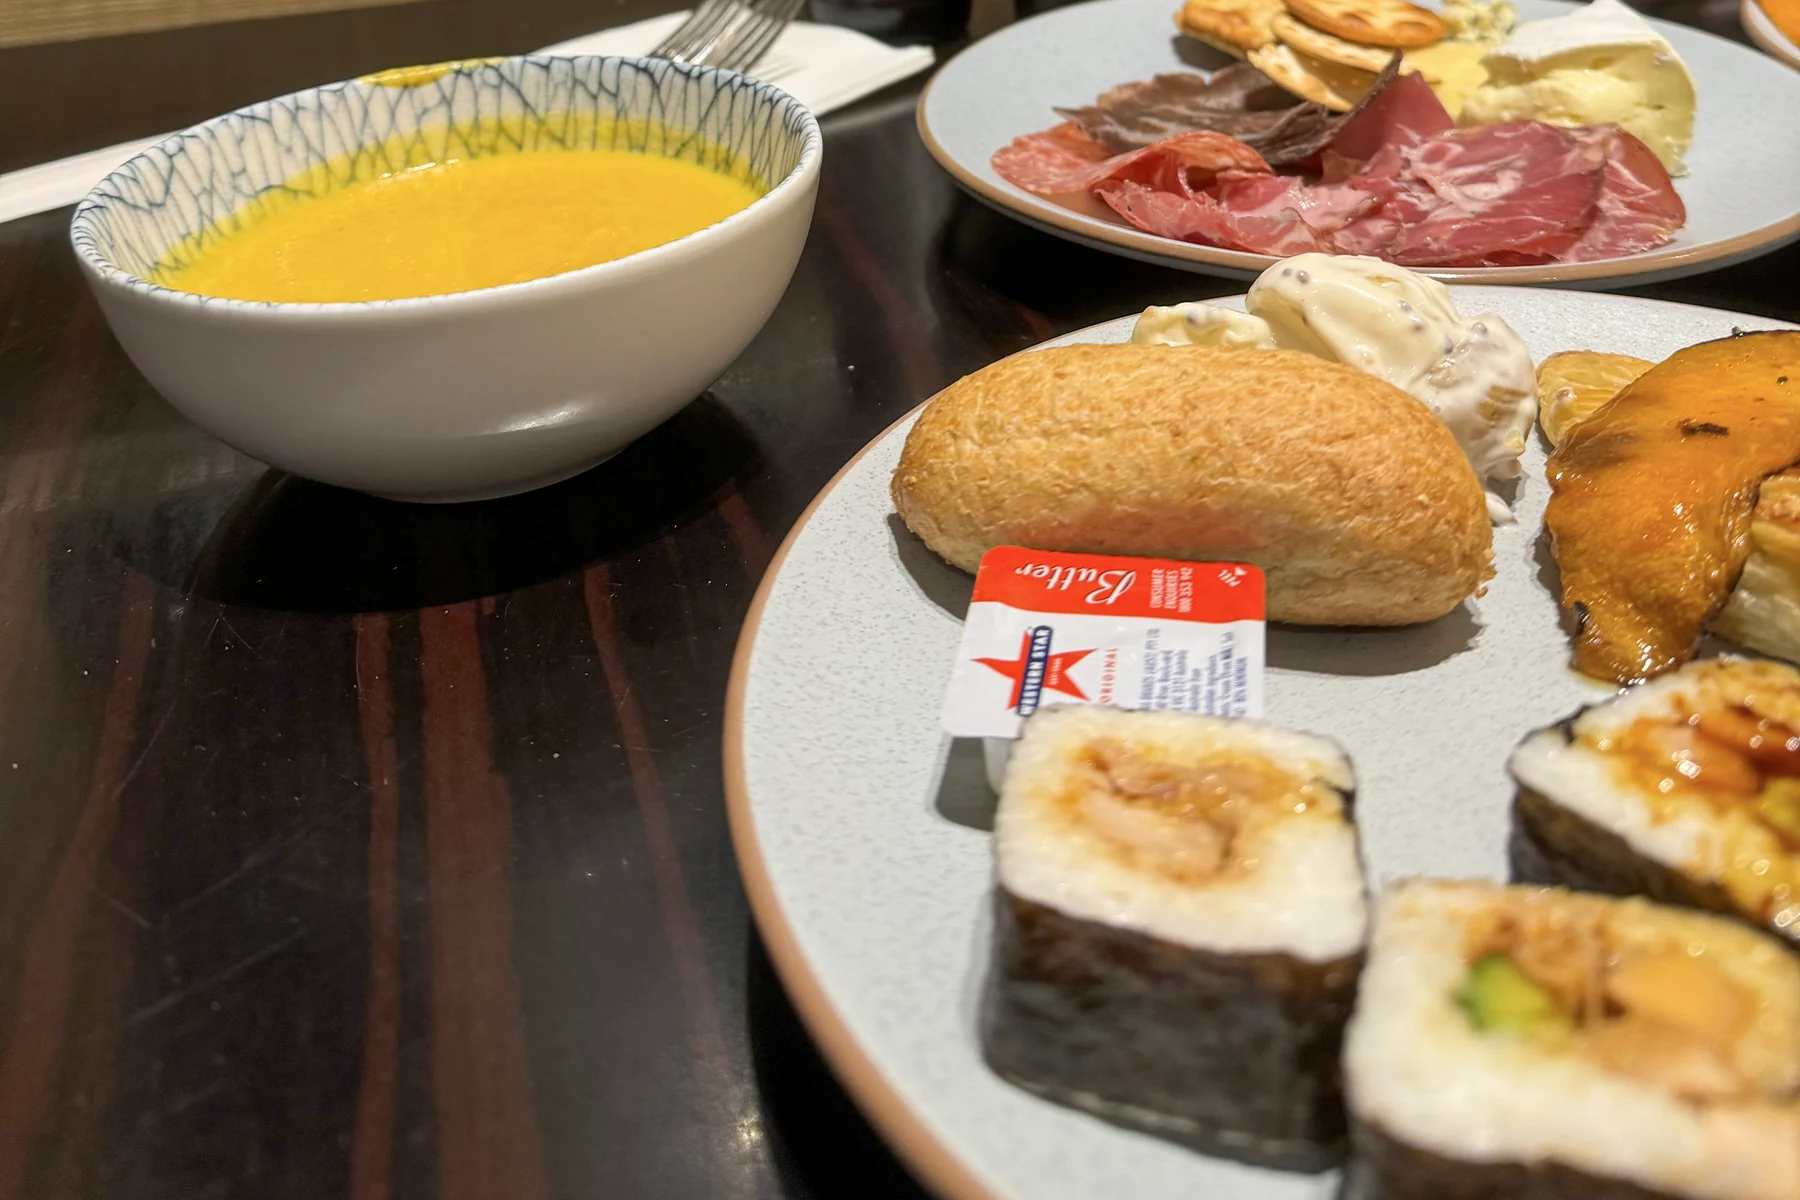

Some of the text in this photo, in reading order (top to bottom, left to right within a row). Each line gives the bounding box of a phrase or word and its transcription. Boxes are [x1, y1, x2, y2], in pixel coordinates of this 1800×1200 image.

[1014, 562, 1137, 605] Butter
[1018, 629, 1051, 716] WESTERN STAR
[1098, 648, 1119, 704] ORIGINAL
